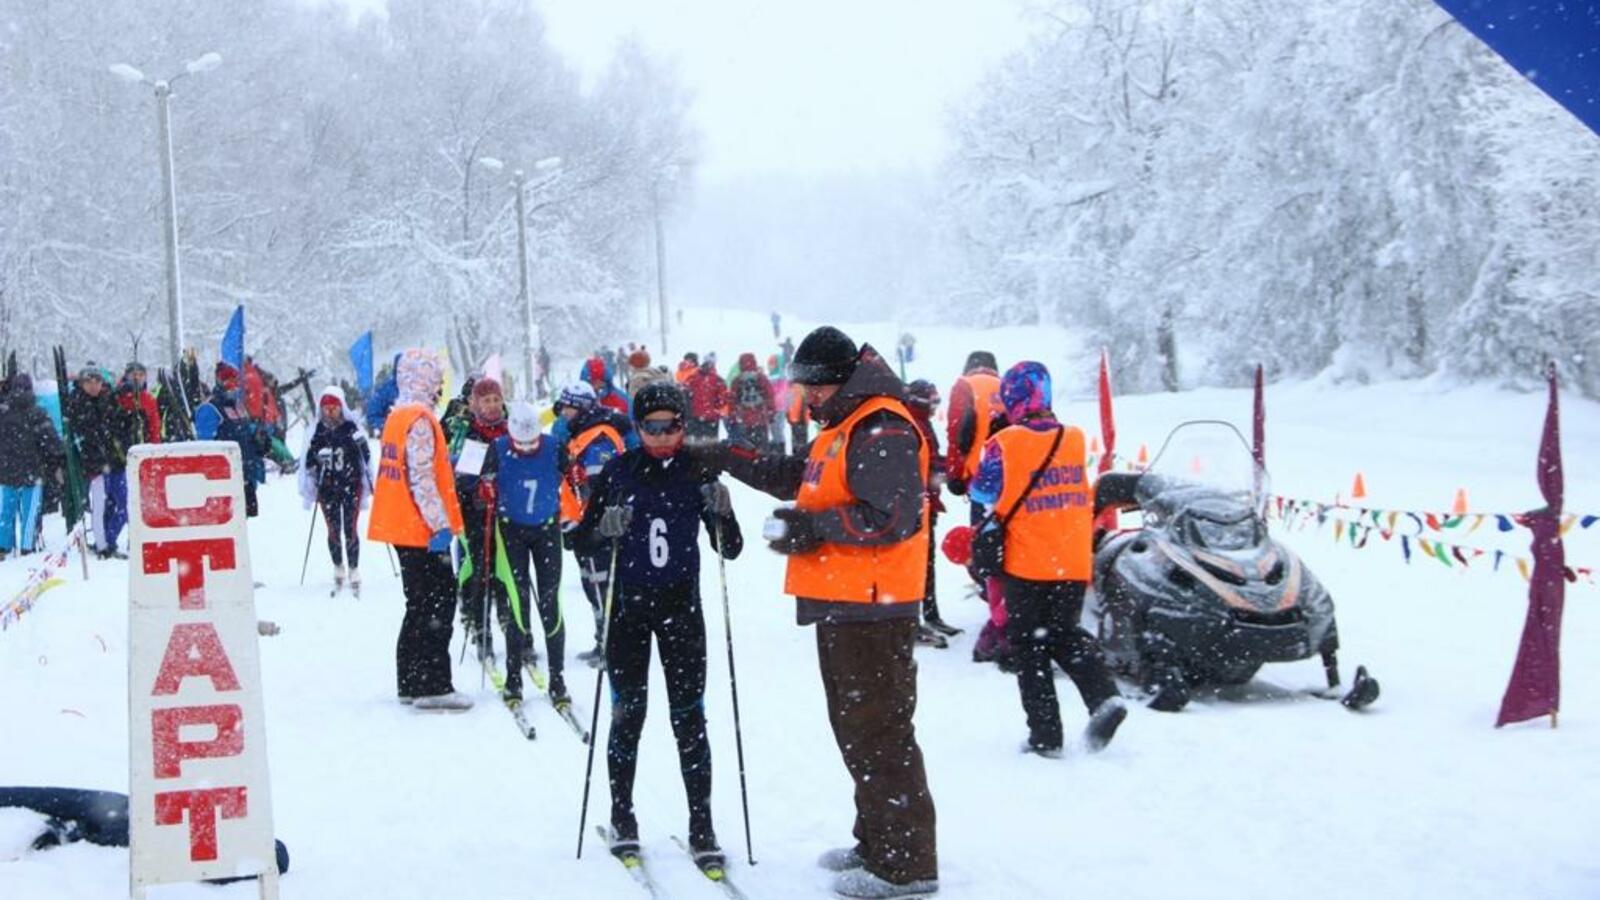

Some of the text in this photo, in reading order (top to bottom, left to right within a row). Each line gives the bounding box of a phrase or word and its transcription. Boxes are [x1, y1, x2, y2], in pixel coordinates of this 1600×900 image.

[523, 479, 538, 514] 7
[649, 517, 669, 568] 6
[137, 453, 249, 863] СТАРТ
